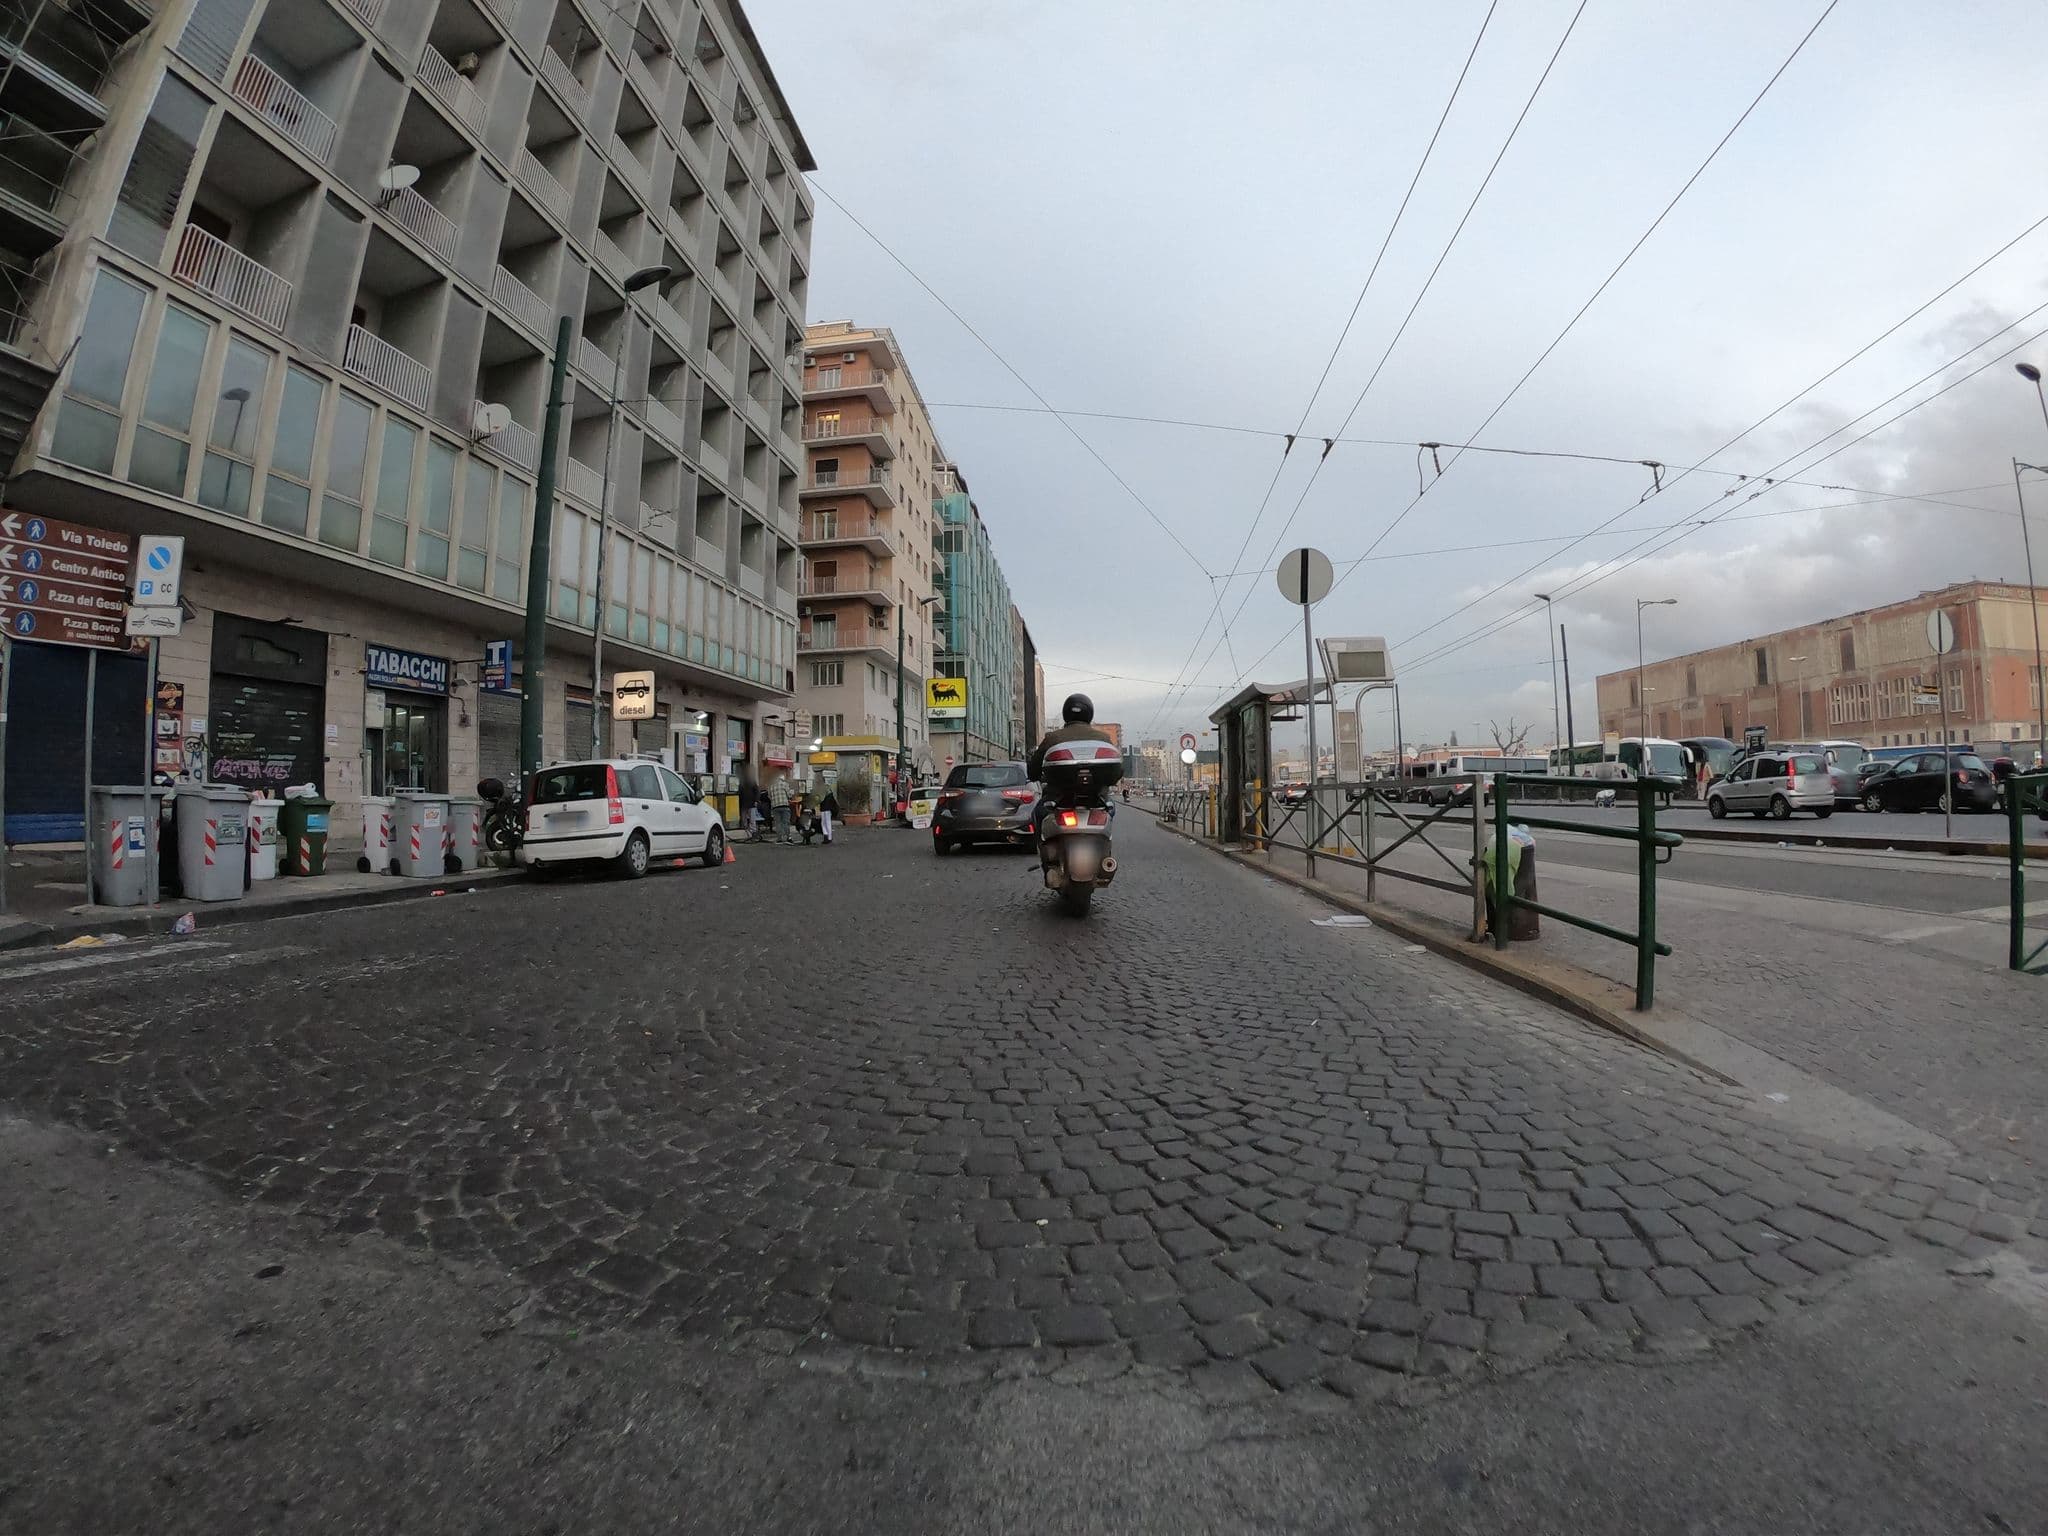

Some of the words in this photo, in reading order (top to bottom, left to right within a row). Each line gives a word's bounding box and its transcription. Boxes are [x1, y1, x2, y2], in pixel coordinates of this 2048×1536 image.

[61, 529, 82, 545] Via
[86, 535, 128, 553] Toledo
[51, 559, 88, 576] Centro
[90, 566, 125, 582] Antico
[48, 590, 75, 605] P.zza
[77, 594, 93, 606] del
[63, 617, 89, 629] P.zza
[91, 621, 120, 634] Bovio
[368, 648, 446, 683] TABACCHI
[620, 704, 646, 715] diesel
[930, 706, 947, 717] Agip
